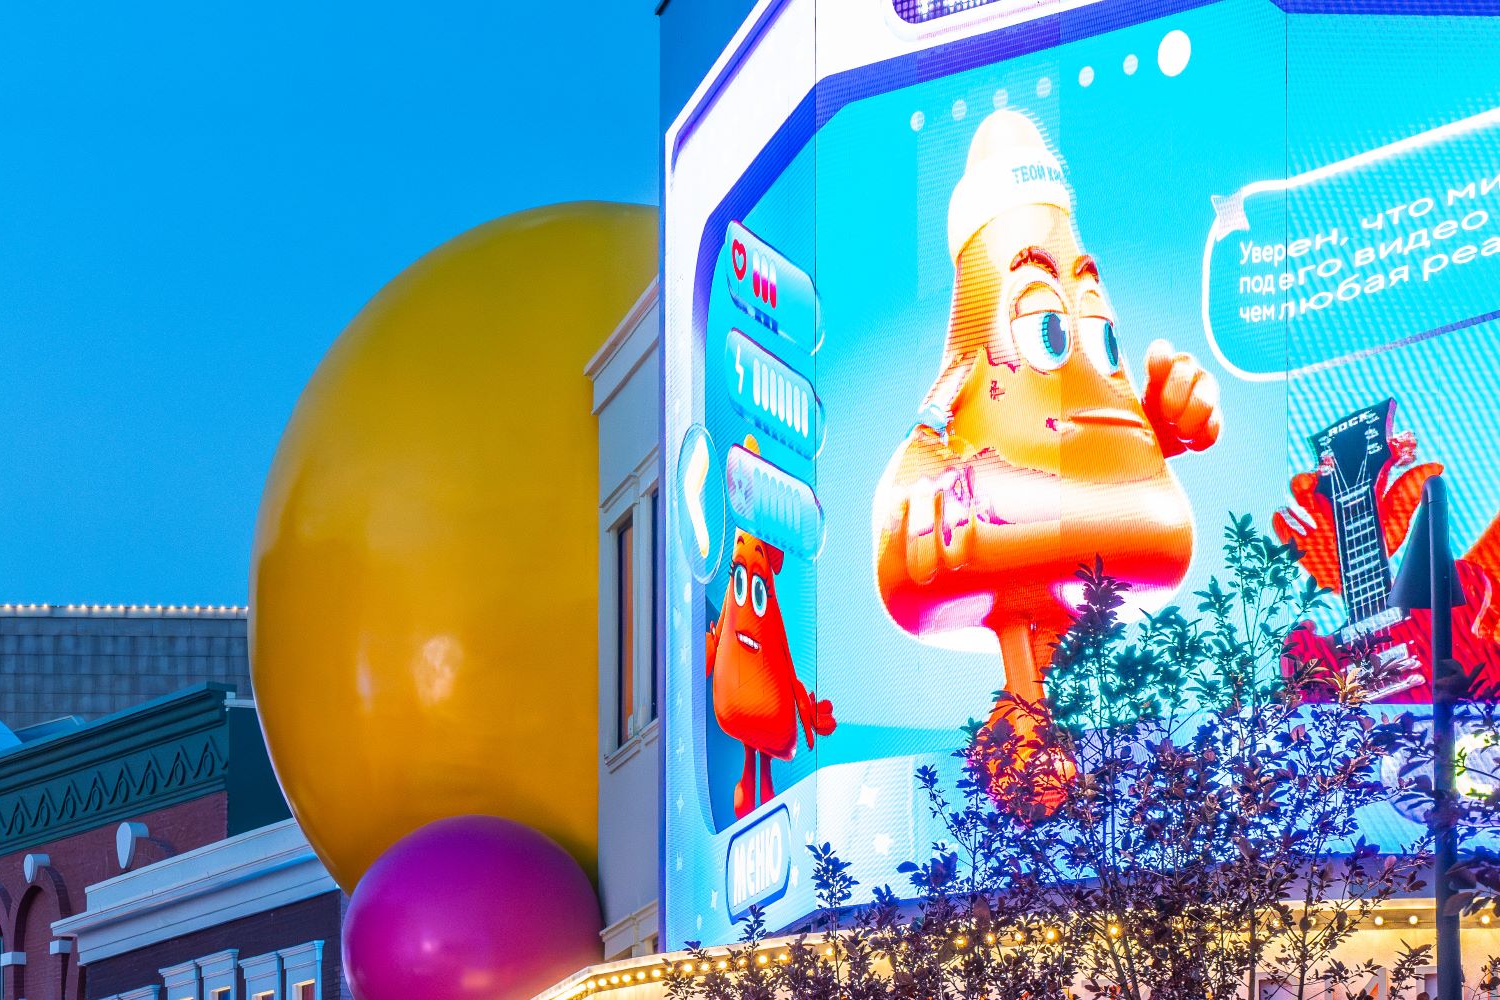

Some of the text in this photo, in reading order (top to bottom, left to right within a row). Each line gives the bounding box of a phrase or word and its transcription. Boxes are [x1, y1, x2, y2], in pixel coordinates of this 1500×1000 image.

[1239, 228, 1350, 267] Уверен,
[1361, 196, 1435, 231] что
[1239, 209, 1489, 294] под его видео
[1239, 303, 1275, 323] чем
[1277, 264, 1410, 321] любая
[733, 821, 783, 907] МЕНЮ
